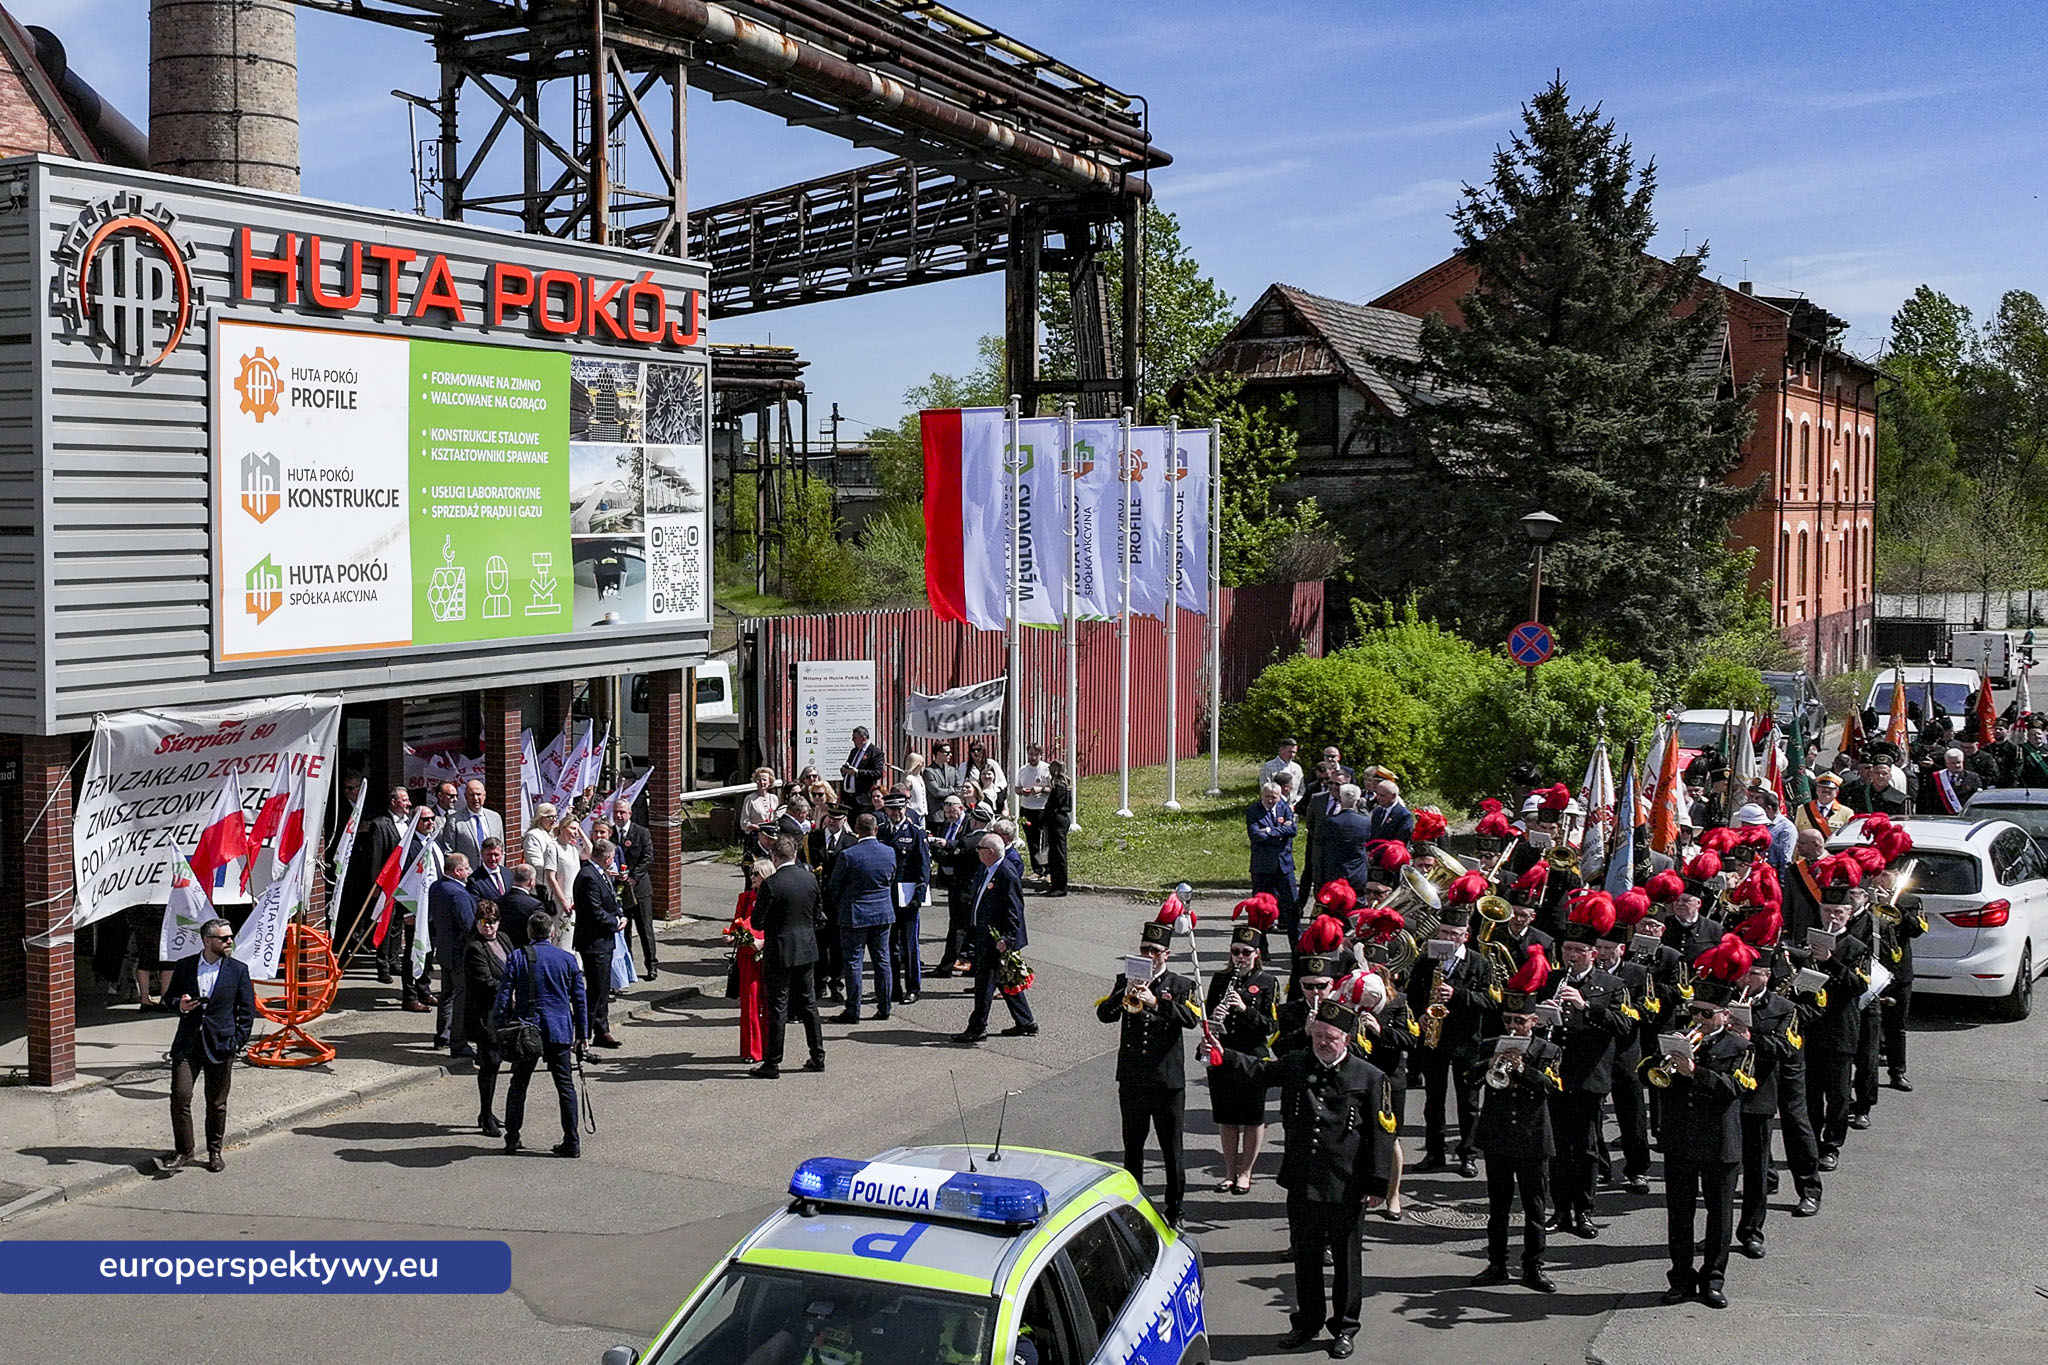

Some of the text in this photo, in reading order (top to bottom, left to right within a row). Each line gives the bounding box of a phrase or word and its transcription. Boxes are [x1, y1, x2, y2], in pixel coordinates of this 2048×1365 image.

[241, 226, 699, 347] HUTA POKÓJ
[291, 367, 358, 385] HUTA POKÓJ
[431, 371, 542, 392] FORMOWANE NA ZIMNO
[291, 387, 358, 410] PROFILE
[431, 391, 547, 412] WALCOWANE NA GORĄCO
[431, 428, 540, 445] KONSTRUKCJE STALOWE
[431, 447, 549, 464] KSZTAŁTOWNIKI SPAWANE
[287, 466, 355, 482] HUTA POKÓJ
[288, 488, 400, 508] KONSTRUKCJE
[431, 485, 541, 500] USŁUGI LABORATORYJNE
[431, 502, 480, 519] SPRZEDAŻ
[480, 505, 512, 520] PRĄDU
[518, 505, 543, 519] GAZU
[1129, 498, 1142, 565] PROFILE
[1083, 506, 1093, 596] SPÓŁKA AKCYJNA
[289, 558, 389, 585] HUTA POKÓJ
[289, 589, 378, 606] SPÓŁKA AKCYJNA
[154, 722, 278, 756] Sierpień 80
[83, 772, 124, 804] TEN
[117, 761, 210, 793] ZAKŁAD
[86, 789, 214, 841] ZNISZCZONY
[134, 861, 168, 887] UE
[852, 1179, 930, 1211] POLICJA
